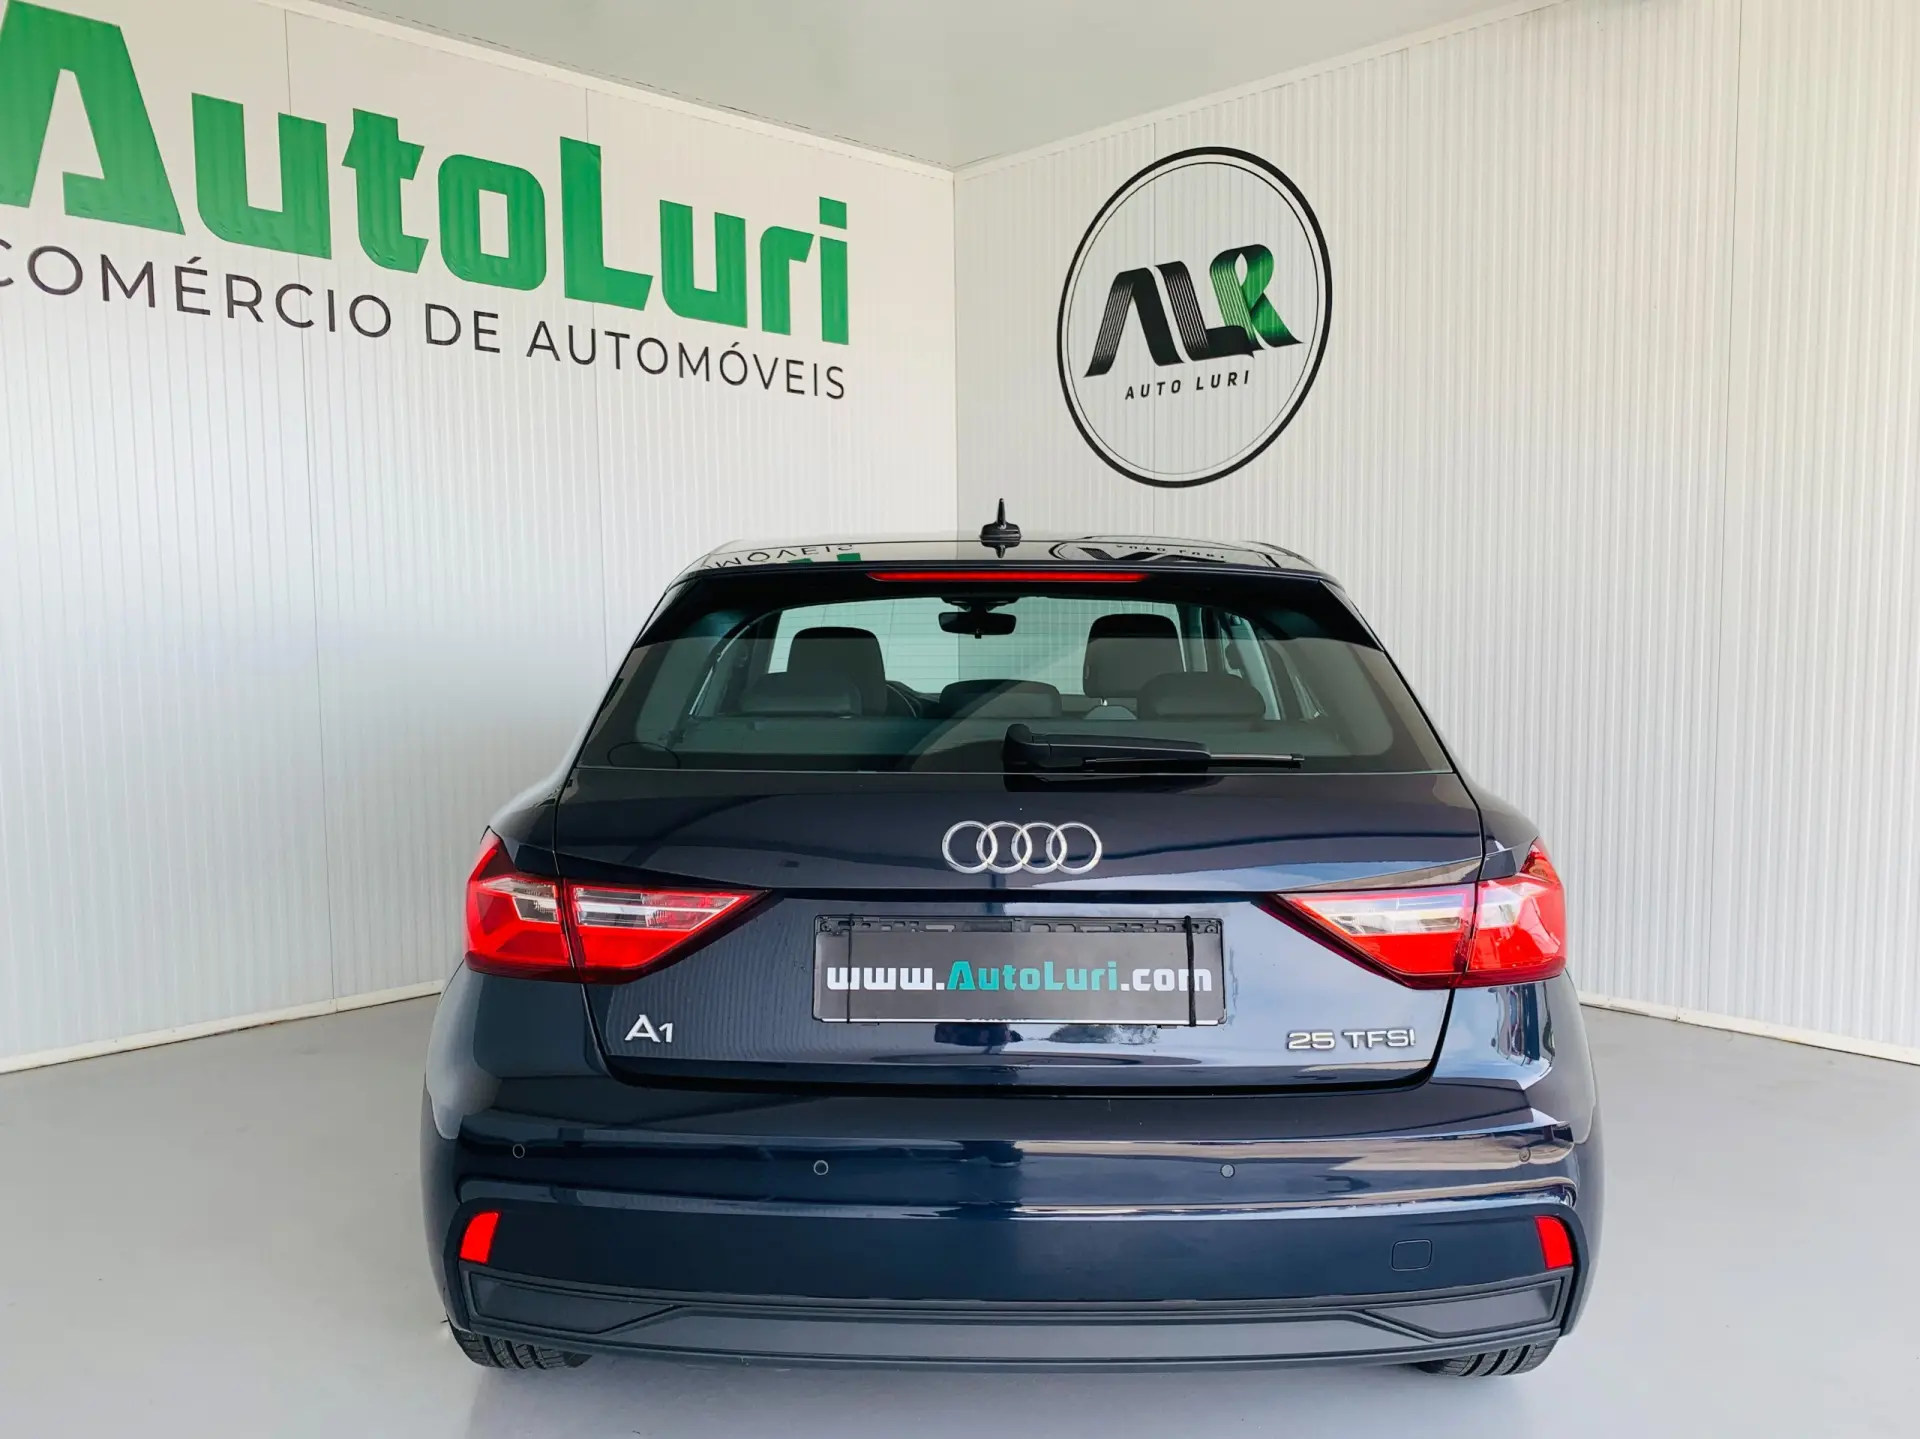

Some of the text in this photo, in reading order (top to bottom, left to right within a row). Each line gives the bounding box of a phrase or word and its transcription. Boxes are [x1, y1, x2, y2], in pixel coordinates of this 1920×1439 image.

[0, 0, 849, 346] AutoLuri
[0, 237, 846, 400] OMÉRCIO DE AUTOMÓVEIS
[1125, 370, 1250, 400] AUTO LURI
[826, 961, 1212, 991] www.AutoLuri.com
[624, 1014, 673, 1043] A1
[1287, 1028, 1415, 1050] 25 TFSI
